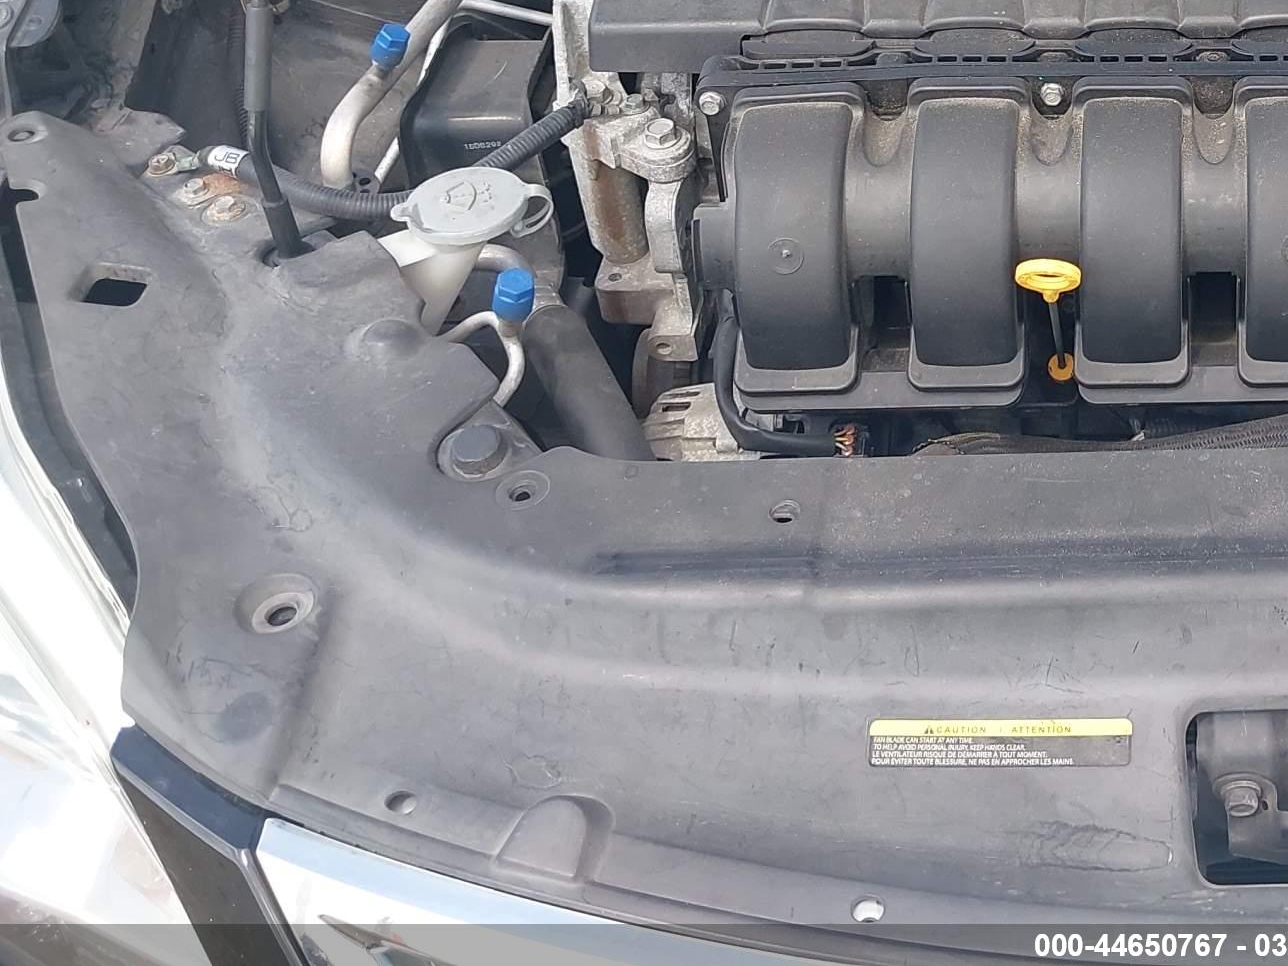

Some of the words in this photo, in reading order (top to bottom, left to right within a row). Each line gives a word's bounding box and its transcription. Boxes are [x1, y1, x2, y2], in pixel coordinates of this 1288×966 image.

[214, 151, 240, 164] JB
[936, 726, 986, 734] CAUTION
[1011, 726, 1072, 734] ATTENTION
[873, 736, 886, 744] FAN
[905, 736, 919, 744] CAN
[919, 736, 937, 744] START
[945, 736, 958, 744] ANY
[873, 743, 882, 751] TO
[882, 743, 897, 751] HELP
[898, 743, 917, 751] AVOID
[917, 743, 947, 751] PERSONAL
[970, 743, 985, 751] KEEP
[872, 750, 880, 758] LE
[880, 750, 923, 758] VENTILATEUR
[923, 750, 946, 758] RISQUE
[947, 750, 956, 758] DE
[1000, 750, 1016, 758] TOUT
[871, 757, 890, 766] POUR
[913, 757, 934, 766] TOUTE
[968, 757, 977, 766] NE
[978, 757, 990, 766] PAS
[991, 757, 1000, 766] EN
[1001, 757, 1040, 766] APPROCHER
[1040, 757, 1051, 766] LES
